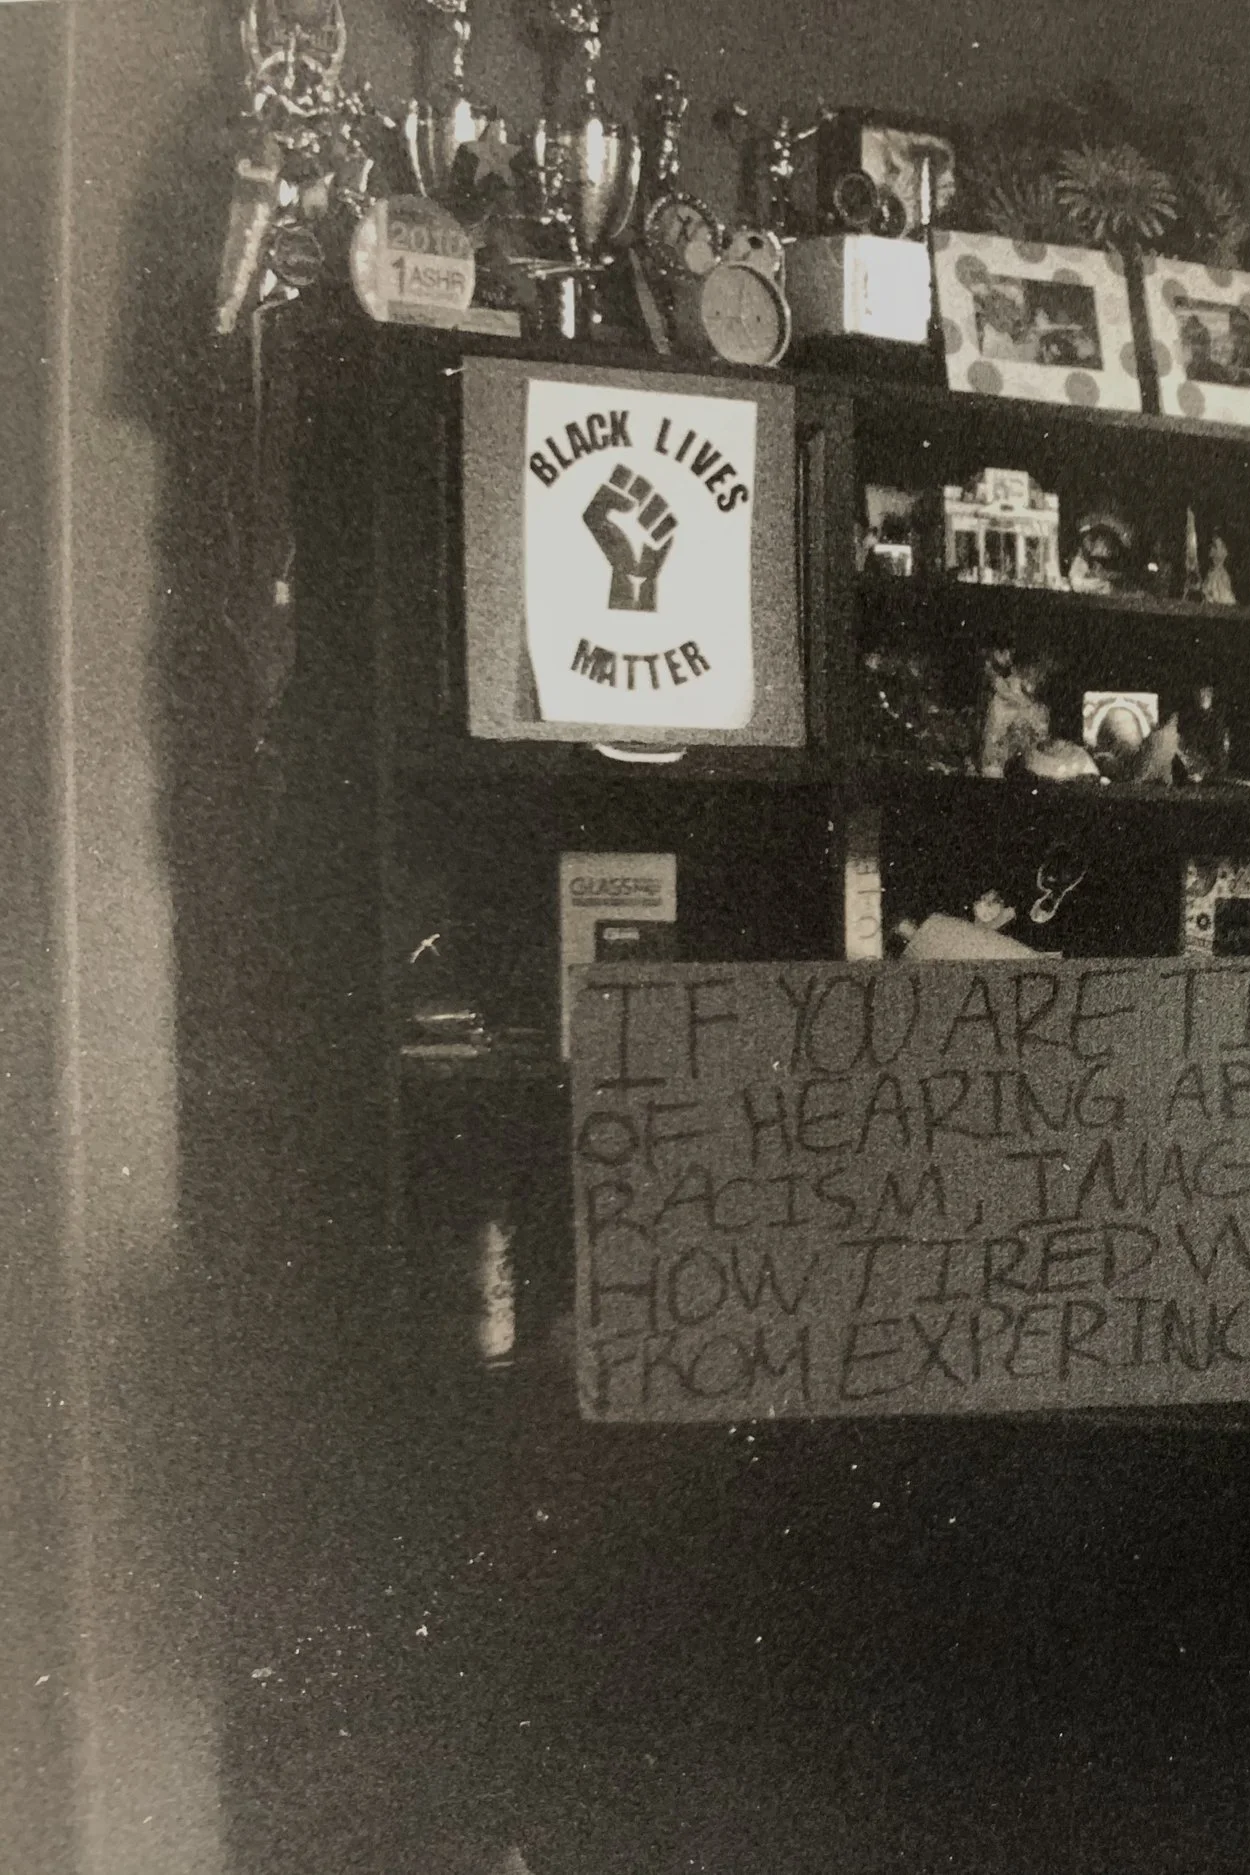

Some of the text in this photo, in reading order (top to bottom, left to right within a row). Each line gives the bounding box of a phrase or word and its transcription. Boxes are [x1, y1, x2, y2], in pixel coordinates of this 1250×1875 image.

[529, 410, 748, 513] BLACK LIVES
[569, 637, 711, 691] MATTER
[583, 977, 738, 1090] IF
[776, 974, 920, 1075] YOU
[941, 968, 1143, 1060] ARE
[577, 1098, 720, 1173] OF
[742, 1066, 1126, 1164] HEARING
[586, 1163, 985, 1242] RACISM,
[590, 1241, 818, 1330] HOW
[840, 1222, 1160, 1310] TIRED
[594, 1324, 816, 1410] FROM
